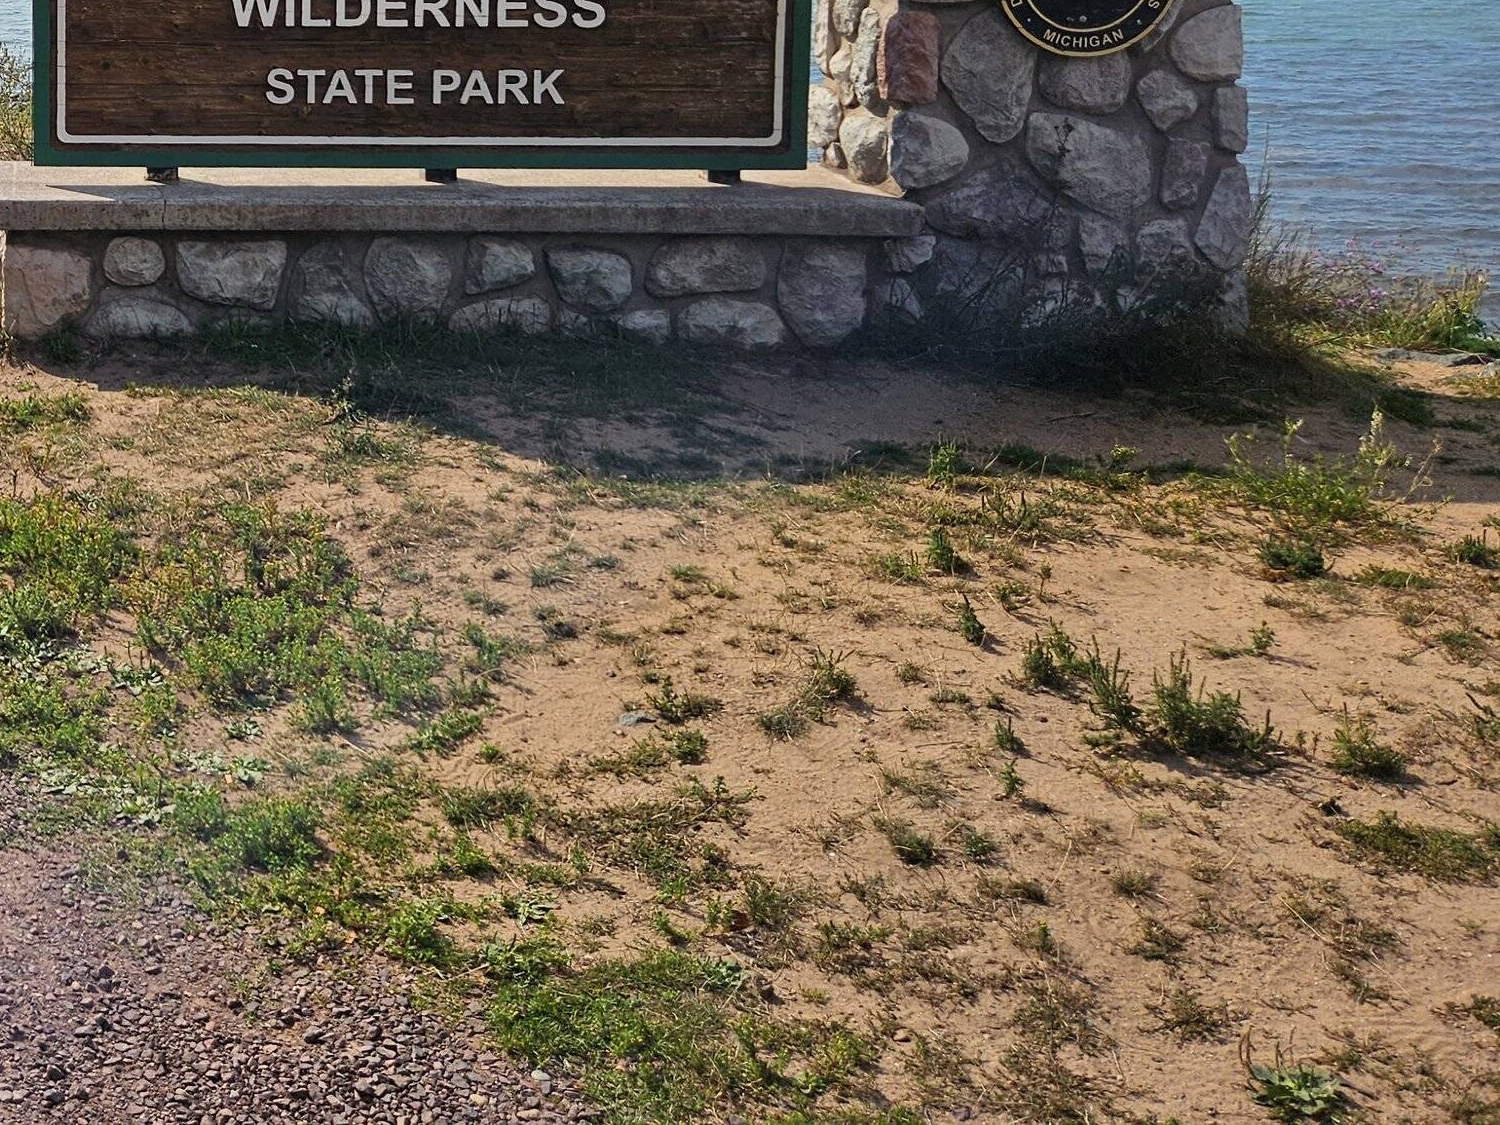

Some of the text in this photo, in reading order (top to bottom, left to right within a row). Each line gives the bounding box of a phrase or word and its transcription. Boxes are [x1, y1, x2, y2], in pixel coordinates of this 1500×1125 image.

[1043, 28, 1124, 48] MICHIGAN
[265, 68, 565, 105] STATE PARK
